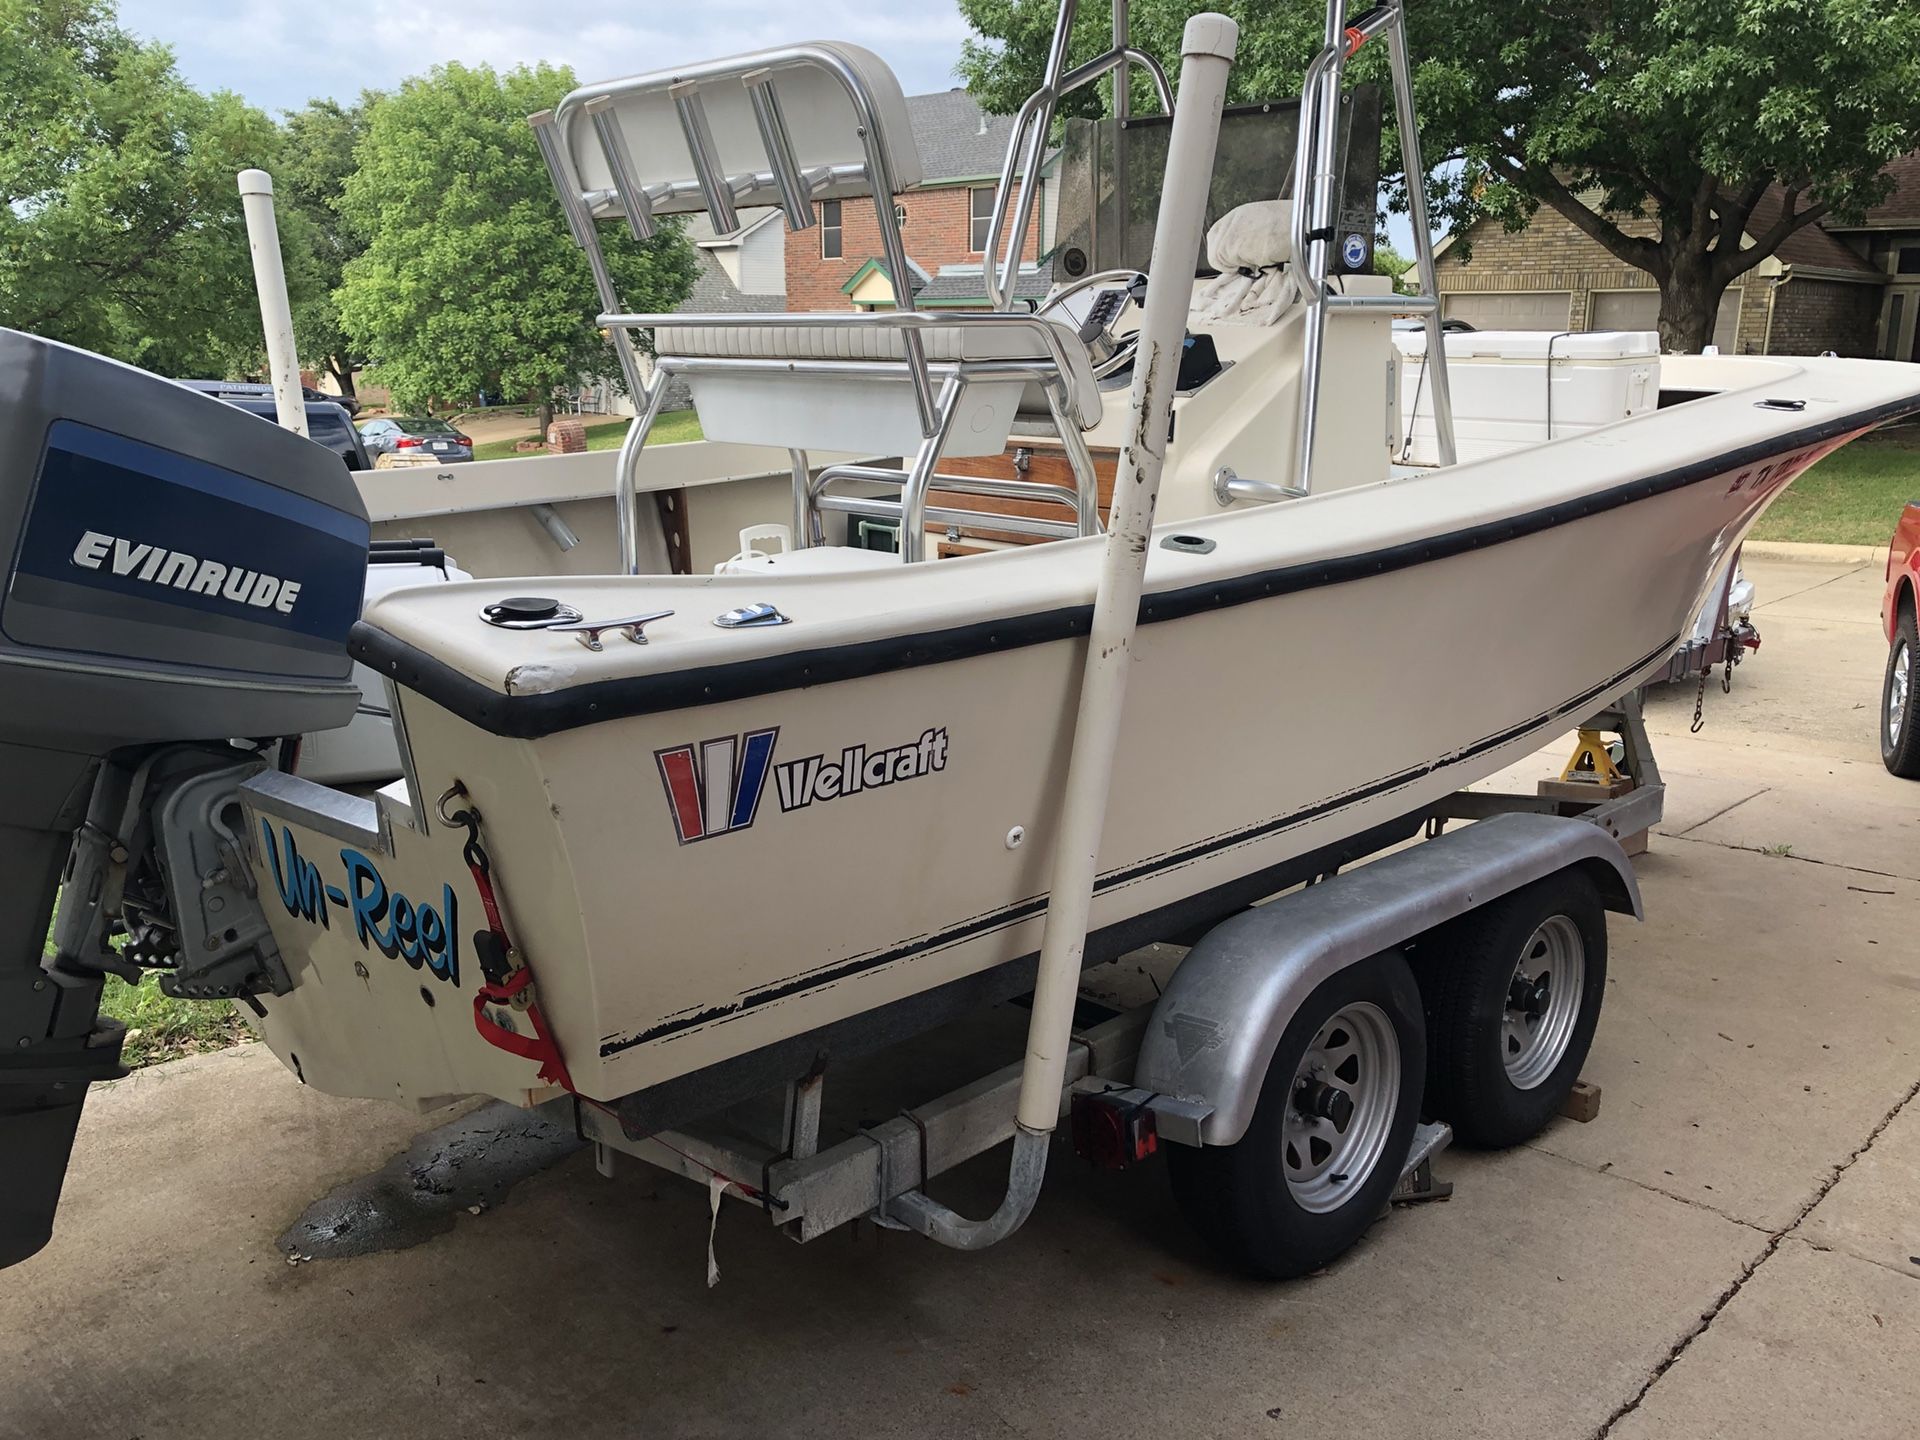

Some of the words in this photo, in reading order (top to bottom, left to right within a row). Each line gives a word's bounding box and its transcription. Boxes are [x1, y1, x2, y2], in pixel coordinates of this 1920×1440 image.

[219, 384, 273, 392] PATHFINDE
[71, 530, 301, 615] EVINRUDE
[774, 727, 948, 812] Wellcraft
[260, 818, 459, 987] Un-Reel
